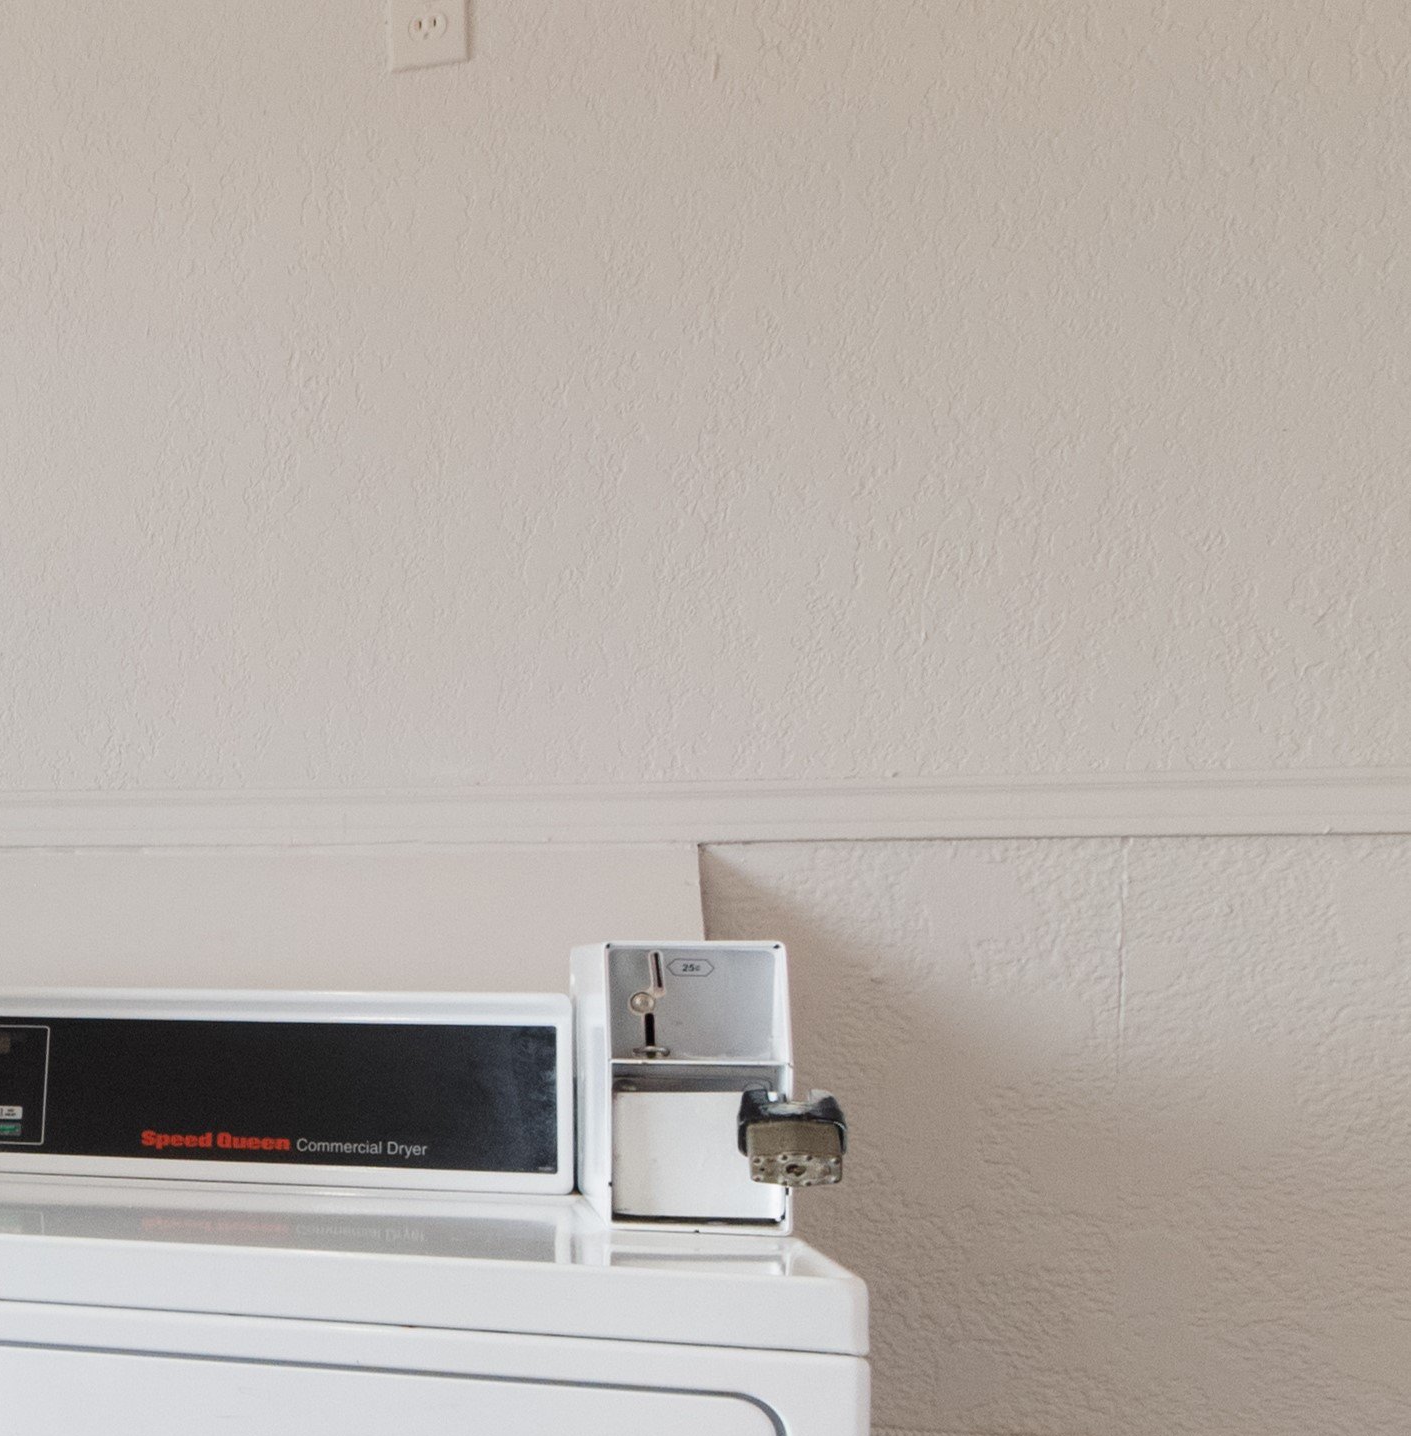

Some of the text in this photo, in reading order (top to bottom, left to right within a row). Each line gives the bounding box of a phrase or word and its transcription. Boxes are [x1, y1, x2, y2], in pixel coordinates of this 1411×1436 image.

[140, 1130, 428, 1159] Speed Queen Commercial Dryer
